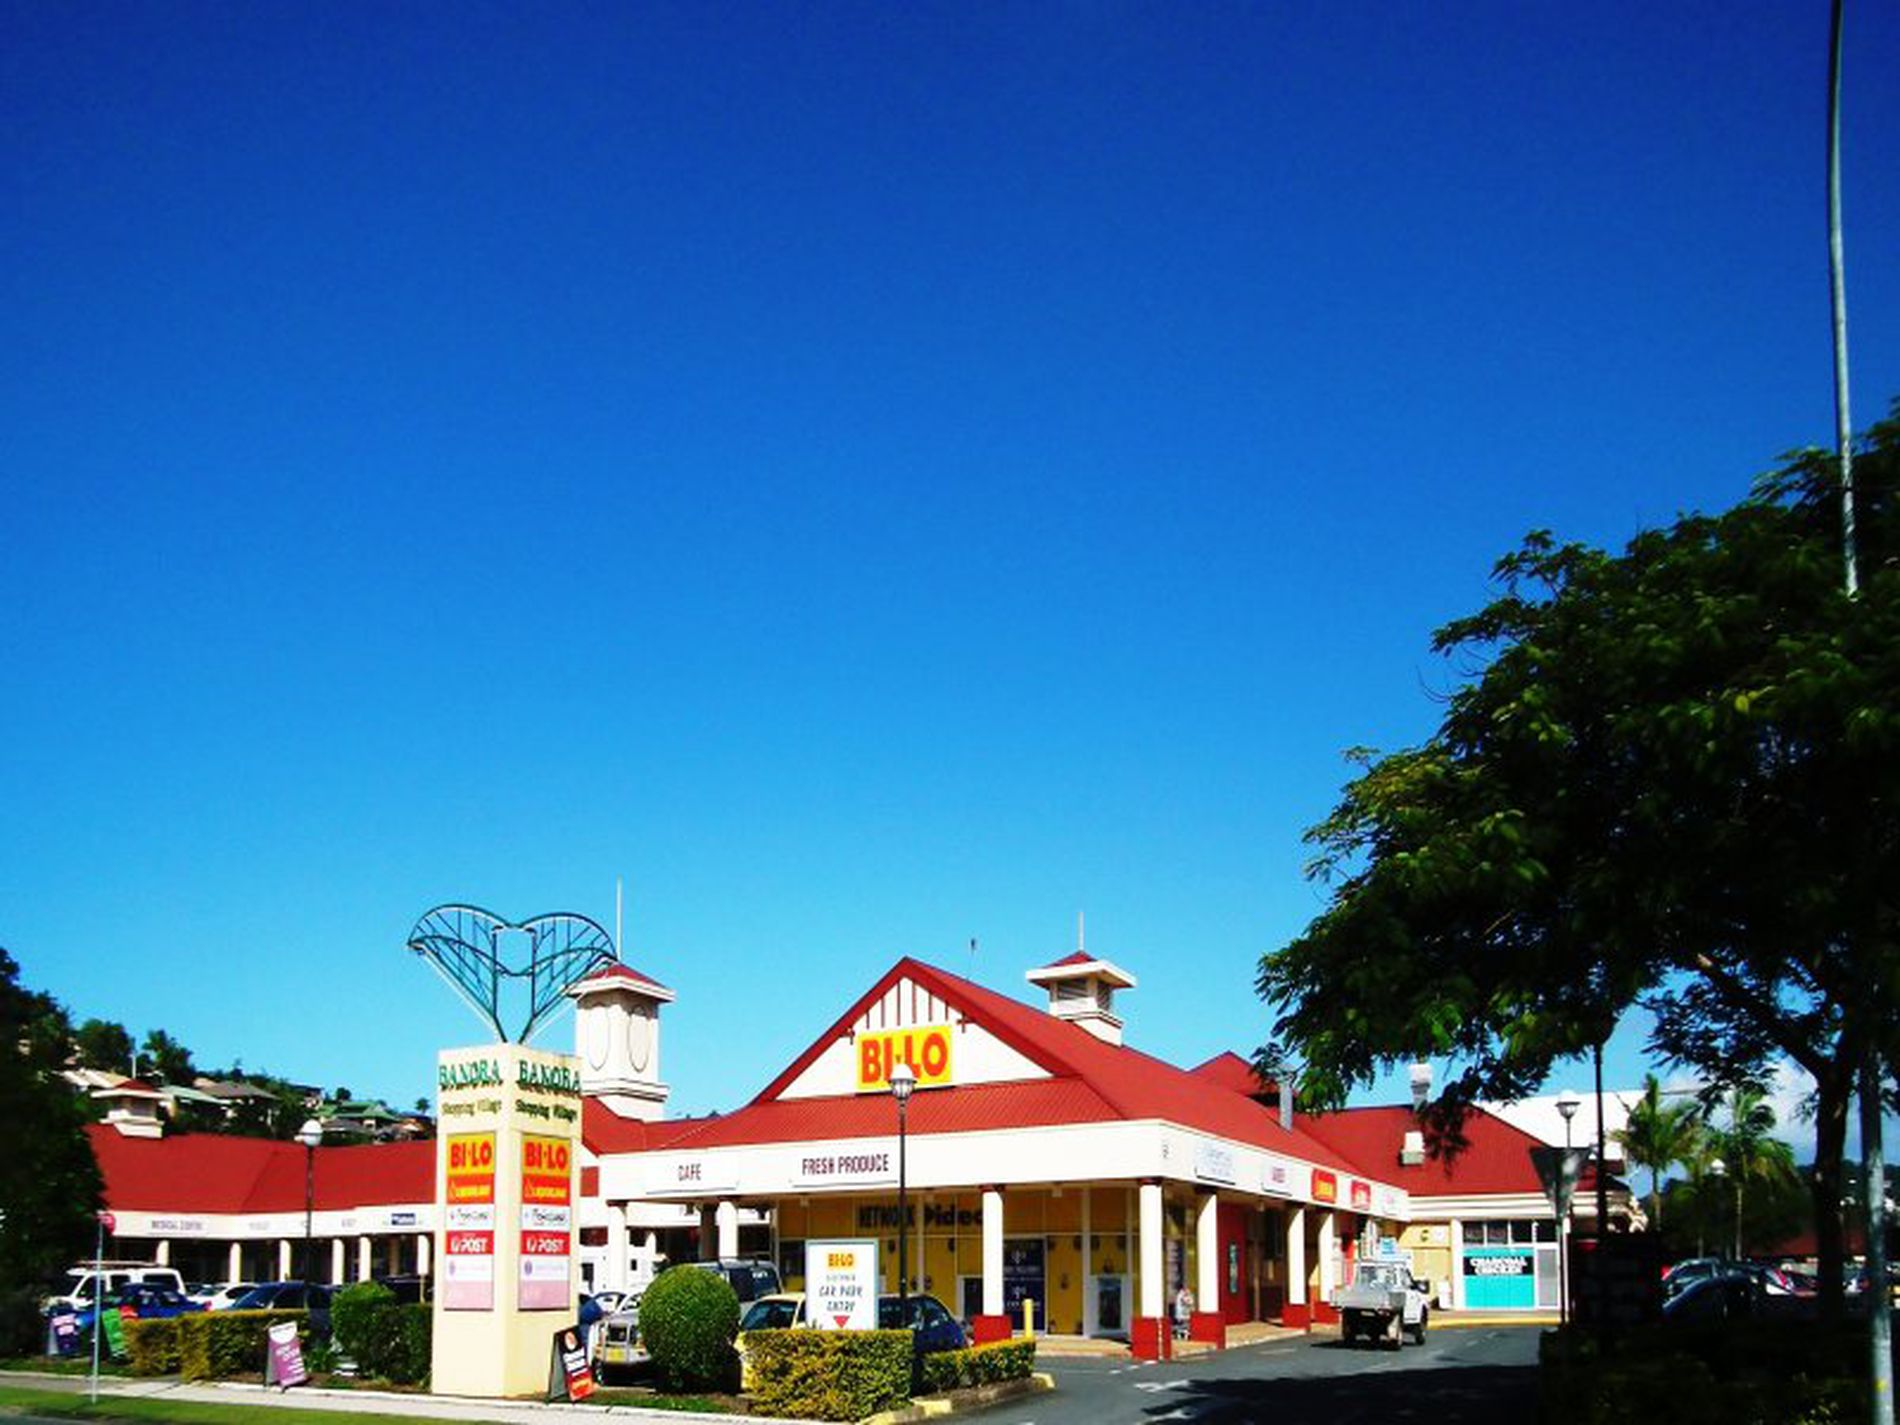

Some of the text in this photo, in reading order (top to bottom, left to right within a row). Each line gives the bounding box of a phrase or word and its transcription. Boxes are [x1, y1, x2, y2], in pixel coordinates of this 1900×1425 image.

[519, 1060, 580, 1093] BANORA
[515, 1099, 550, 1122] Shopping
[678, 1163, 702, 1181] CAFE
[802, 1153, 889, 1176] FRESH PRODUCE
